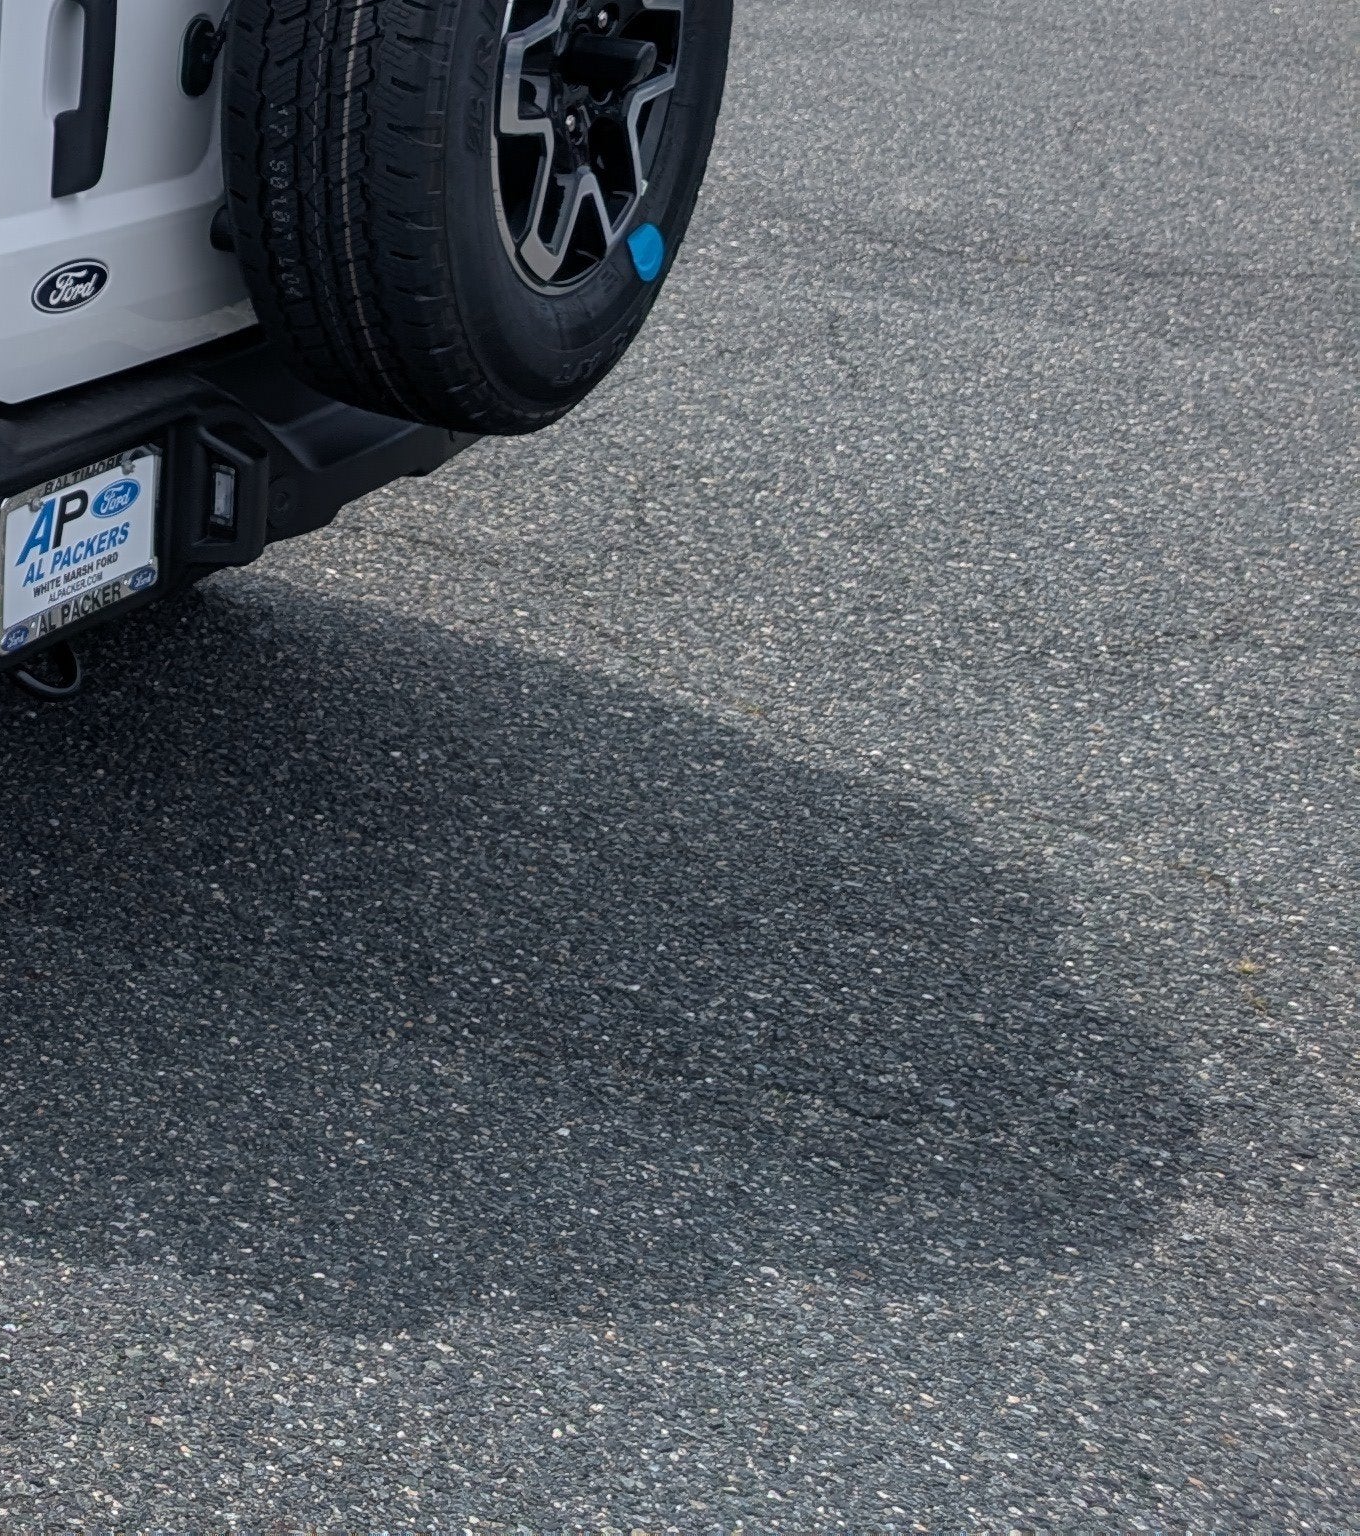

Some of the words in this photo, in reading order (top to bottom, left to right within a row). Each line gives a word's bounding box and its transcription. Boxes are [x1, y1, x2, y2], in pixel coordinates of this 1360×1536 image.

[48, 268, 99, 306] Ford
[44, 452, 124, 494] BALTIMORE
[100, 485, 132, 514] Ford
[15, 489, 89, 567] AP
[23, 558, 45, 588] AL
[50, 521, 130, 574] PACKERS
[33, 575, 61, 598] WHITE
[63, 562, 94, 584] MARSH
[96, 551, 119, 570] FORD
[37, 613, 57, 637] AL
[60, 580, 122, 623] PACKER
[47, 571, 104, 604] ALPACKER.COM
